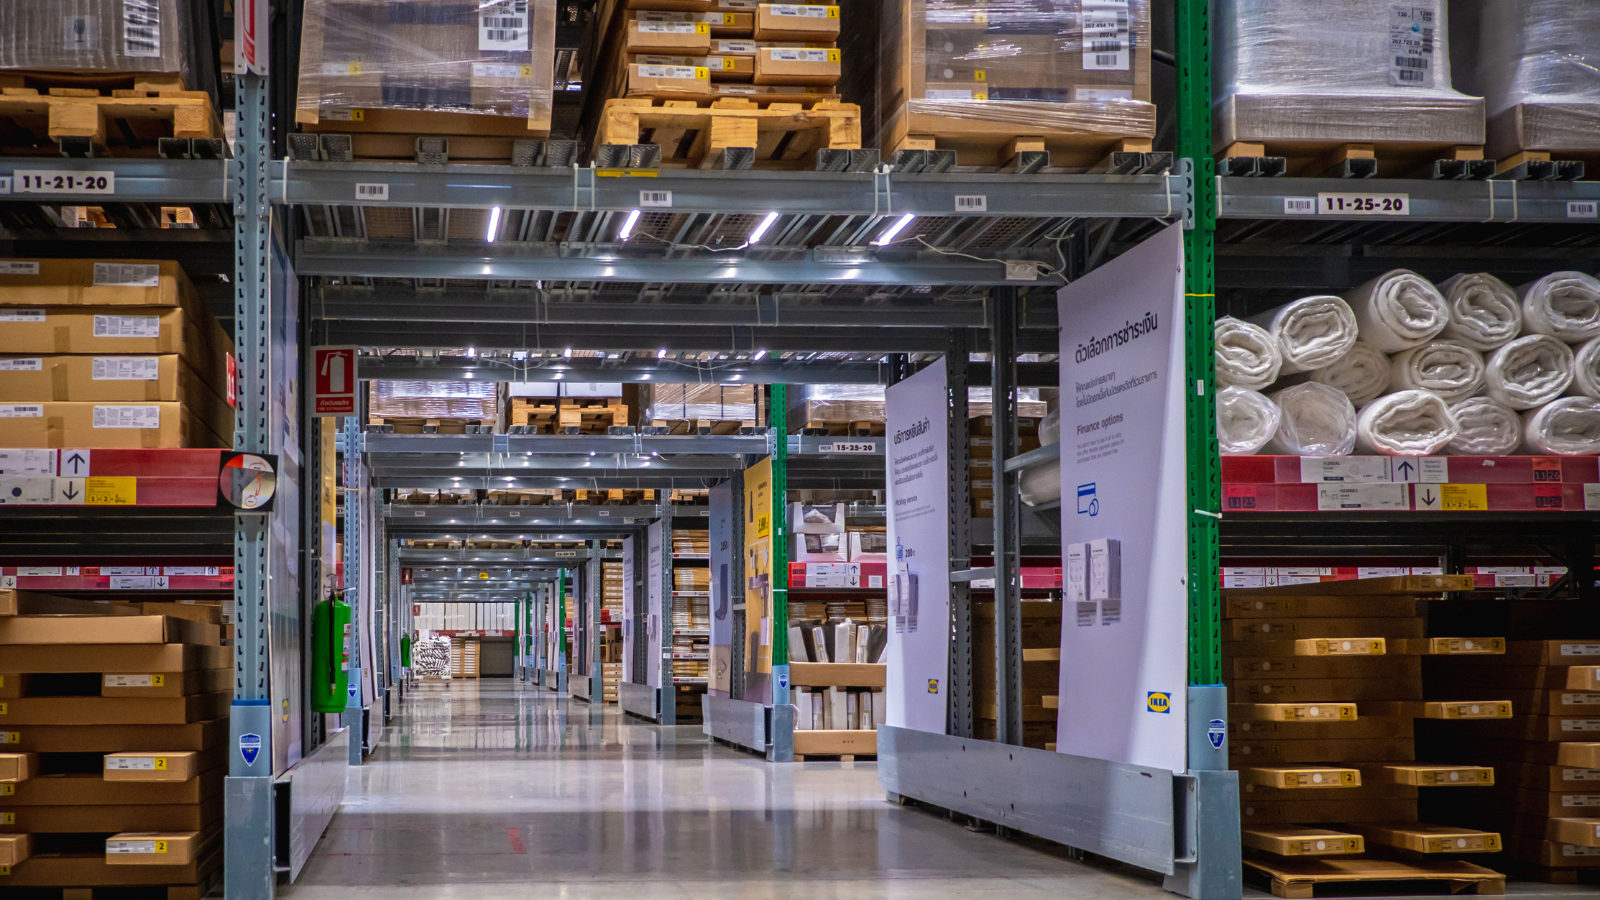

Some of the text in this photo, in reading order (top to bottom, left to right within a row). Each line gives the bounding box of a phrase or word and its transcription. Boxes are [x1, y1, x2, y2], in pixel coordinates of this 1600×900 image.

[23, 175, 108, 190] 11-21-20
[1326, 197, 1403, 212] 11-25-20
[1077, 413, 1123, 436] Finance options
[1535, 470, 1561, 481] 11 26
[895, 495, 918, 507] Picking service
[1229, 497, 1255, 508] 11 25
[1536, 496, 1562, 507] 11 26
[1150, 698, 1167, 707] IKEA
